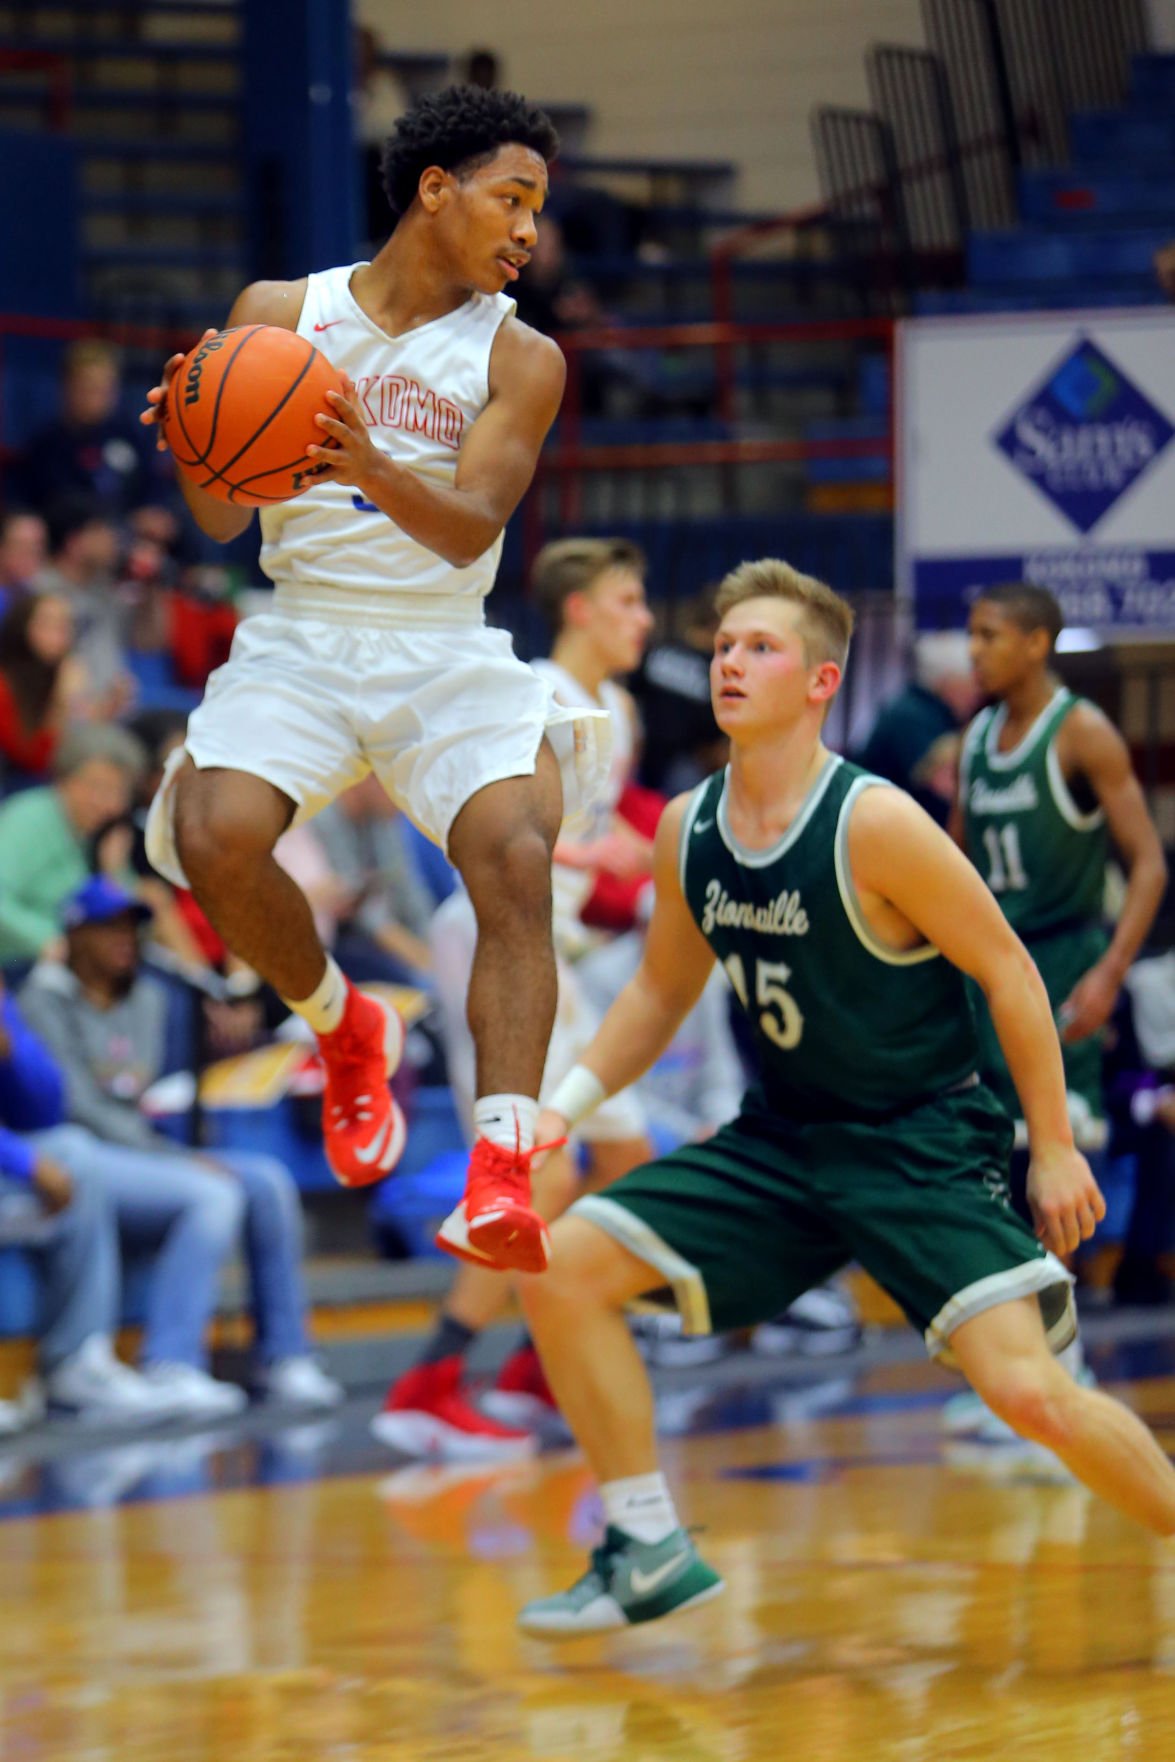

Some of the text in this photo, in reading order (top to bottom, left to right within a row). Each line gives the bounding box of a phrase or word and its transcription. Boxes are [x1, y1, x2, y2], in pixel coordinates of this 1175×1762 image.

[185, 325, 241, 407] ilson
[357, 375, 463, 451] KOMO
[983, 822, 1028, 891] 11
